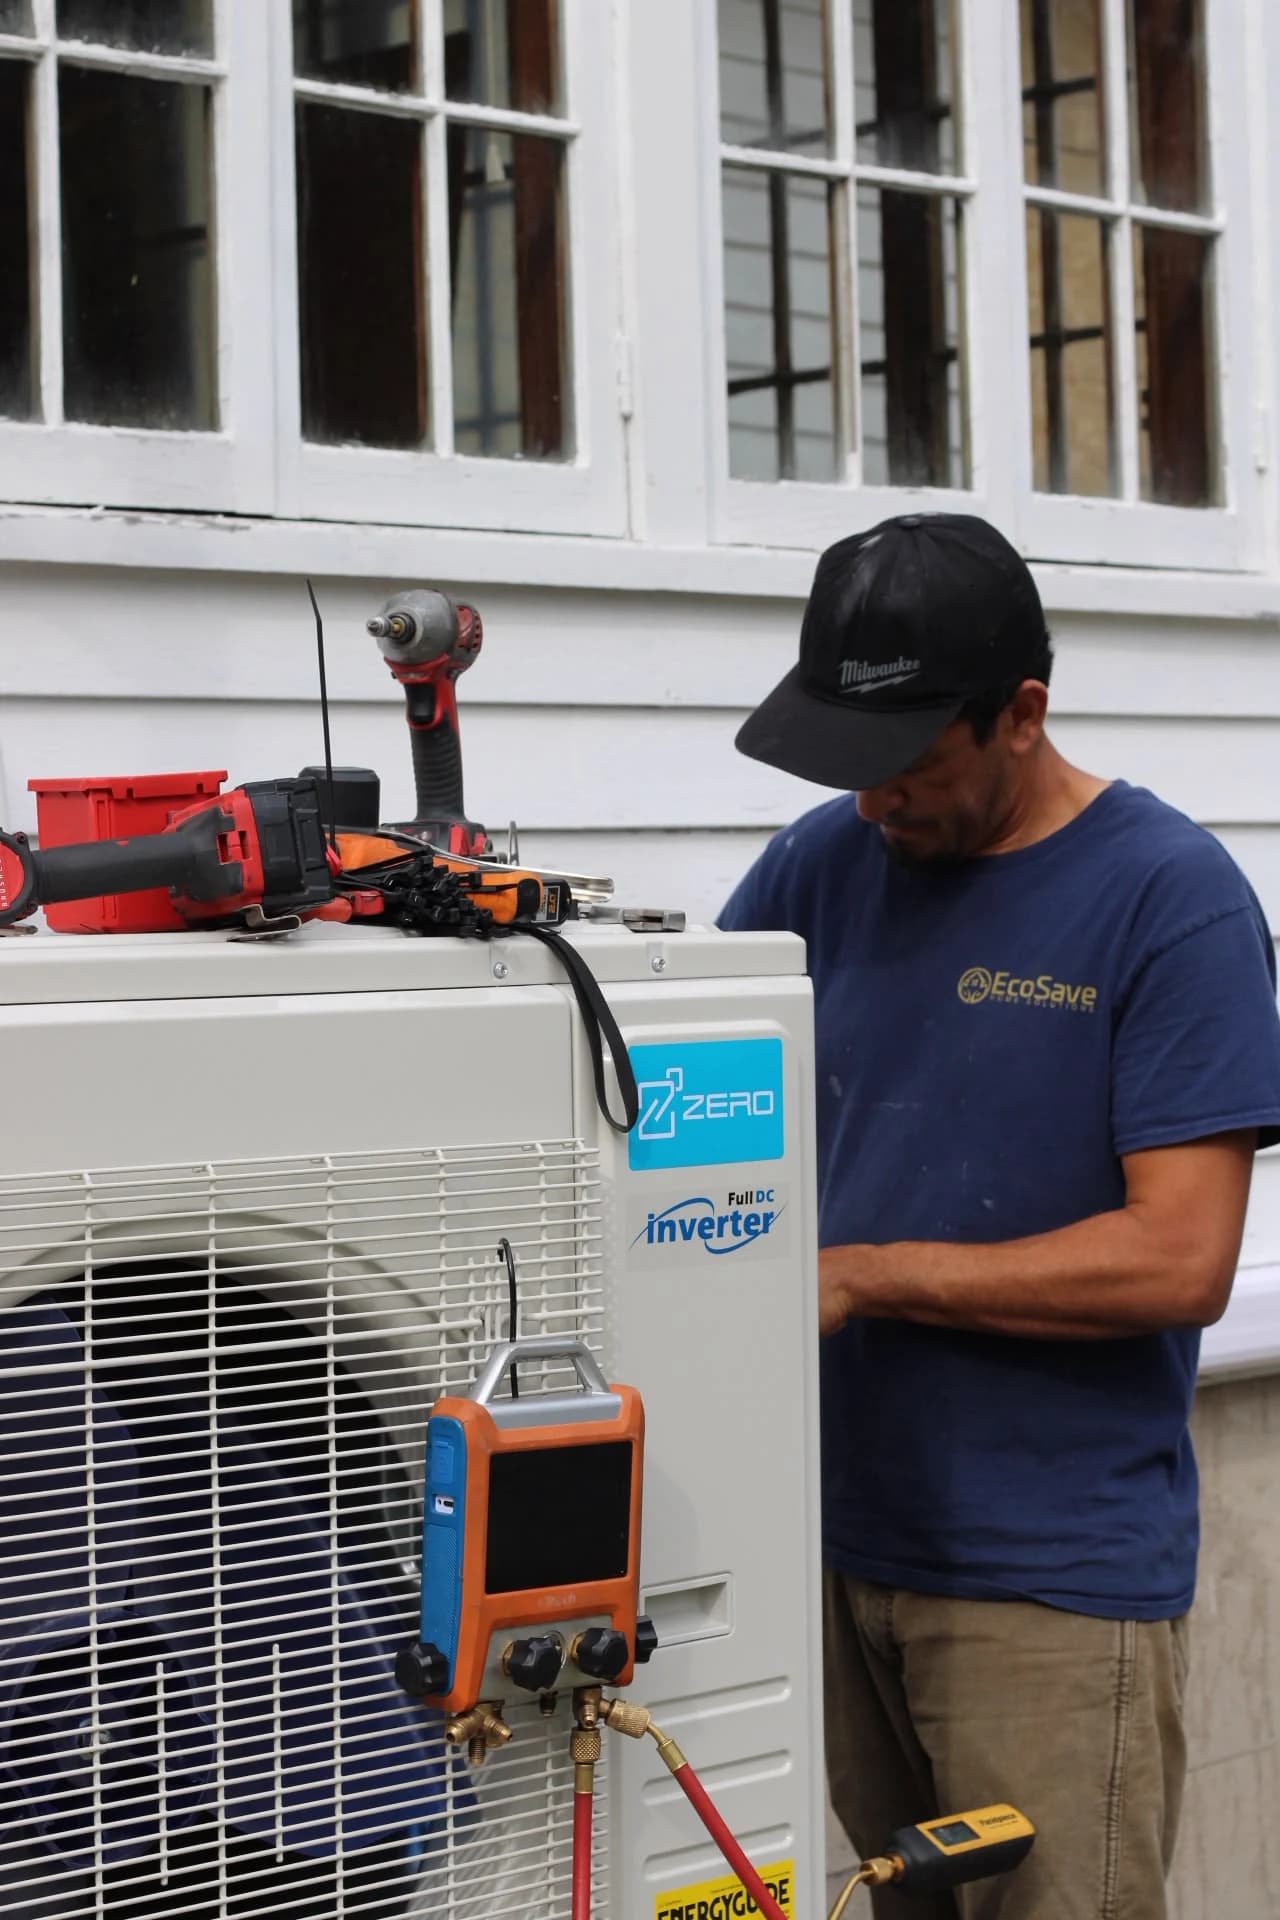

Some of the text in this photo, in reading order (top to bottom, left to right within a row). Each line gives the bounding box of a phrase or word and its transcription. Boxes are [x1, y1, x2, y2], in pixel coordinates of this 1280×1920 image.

[839, 655, 920, 685] Milwaukee
[992, 971, 1097, 1006] EcoSave
[682, 1090, 774, 1120] ZERO
[728, 1189, 775, 1206] Full DC
[647, 1210, 775, 1244] inverter
